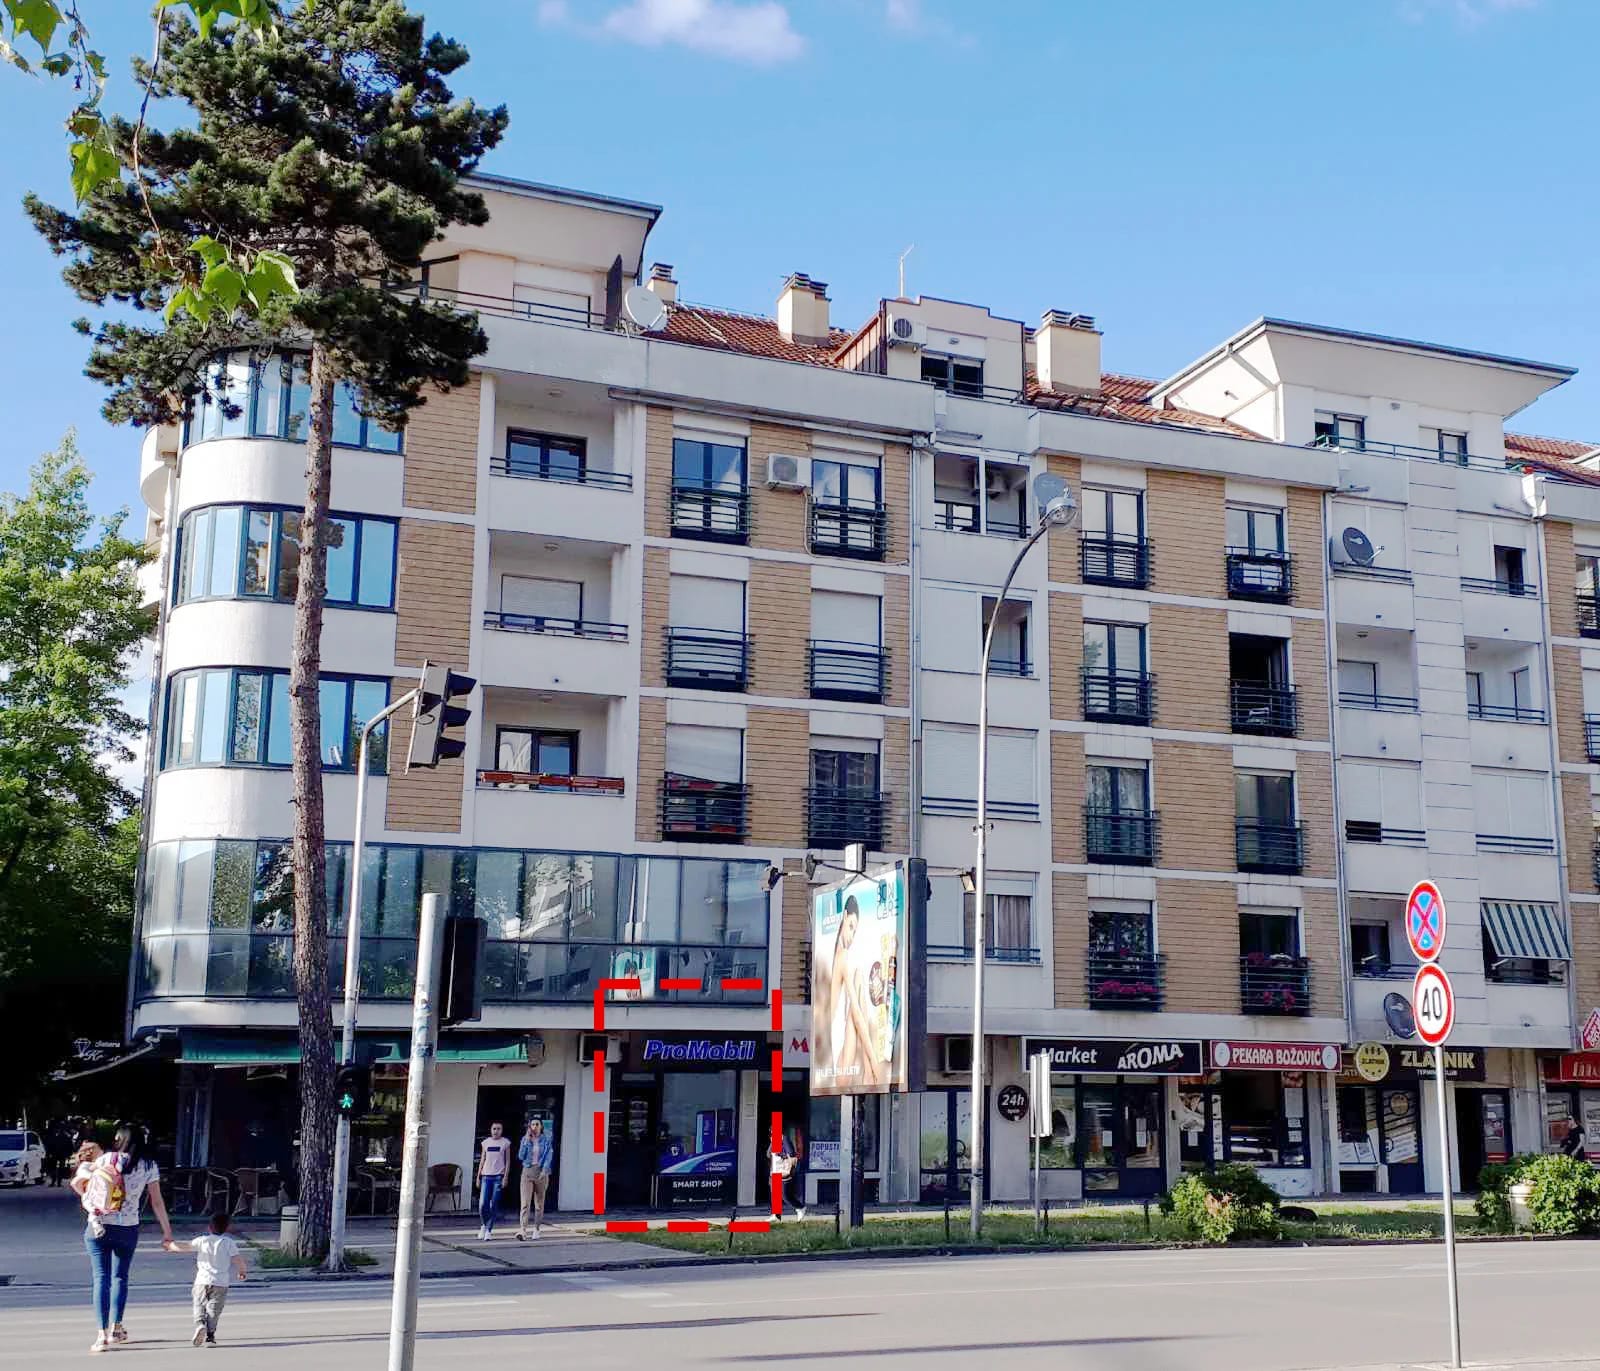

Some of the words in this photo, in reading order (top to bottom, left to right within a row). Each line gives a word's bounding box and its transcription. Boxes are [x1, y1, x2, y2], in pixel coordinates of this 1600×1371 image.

[1422, 986, 1442, 1021] 40
[643, 1039, 756, 1060] ProMobil
[1117, 1043, 1184, 1069] AROMA
[1232, 1047, 1274, 1064] PEKARA
[1400, 1050, 1476, 1069] ZLANIK
[1001, 1094, 1024, 1106] 24h
[672, 1180, 699, 1188] SMART
[701, 1180, 723, 1188] SHOP
